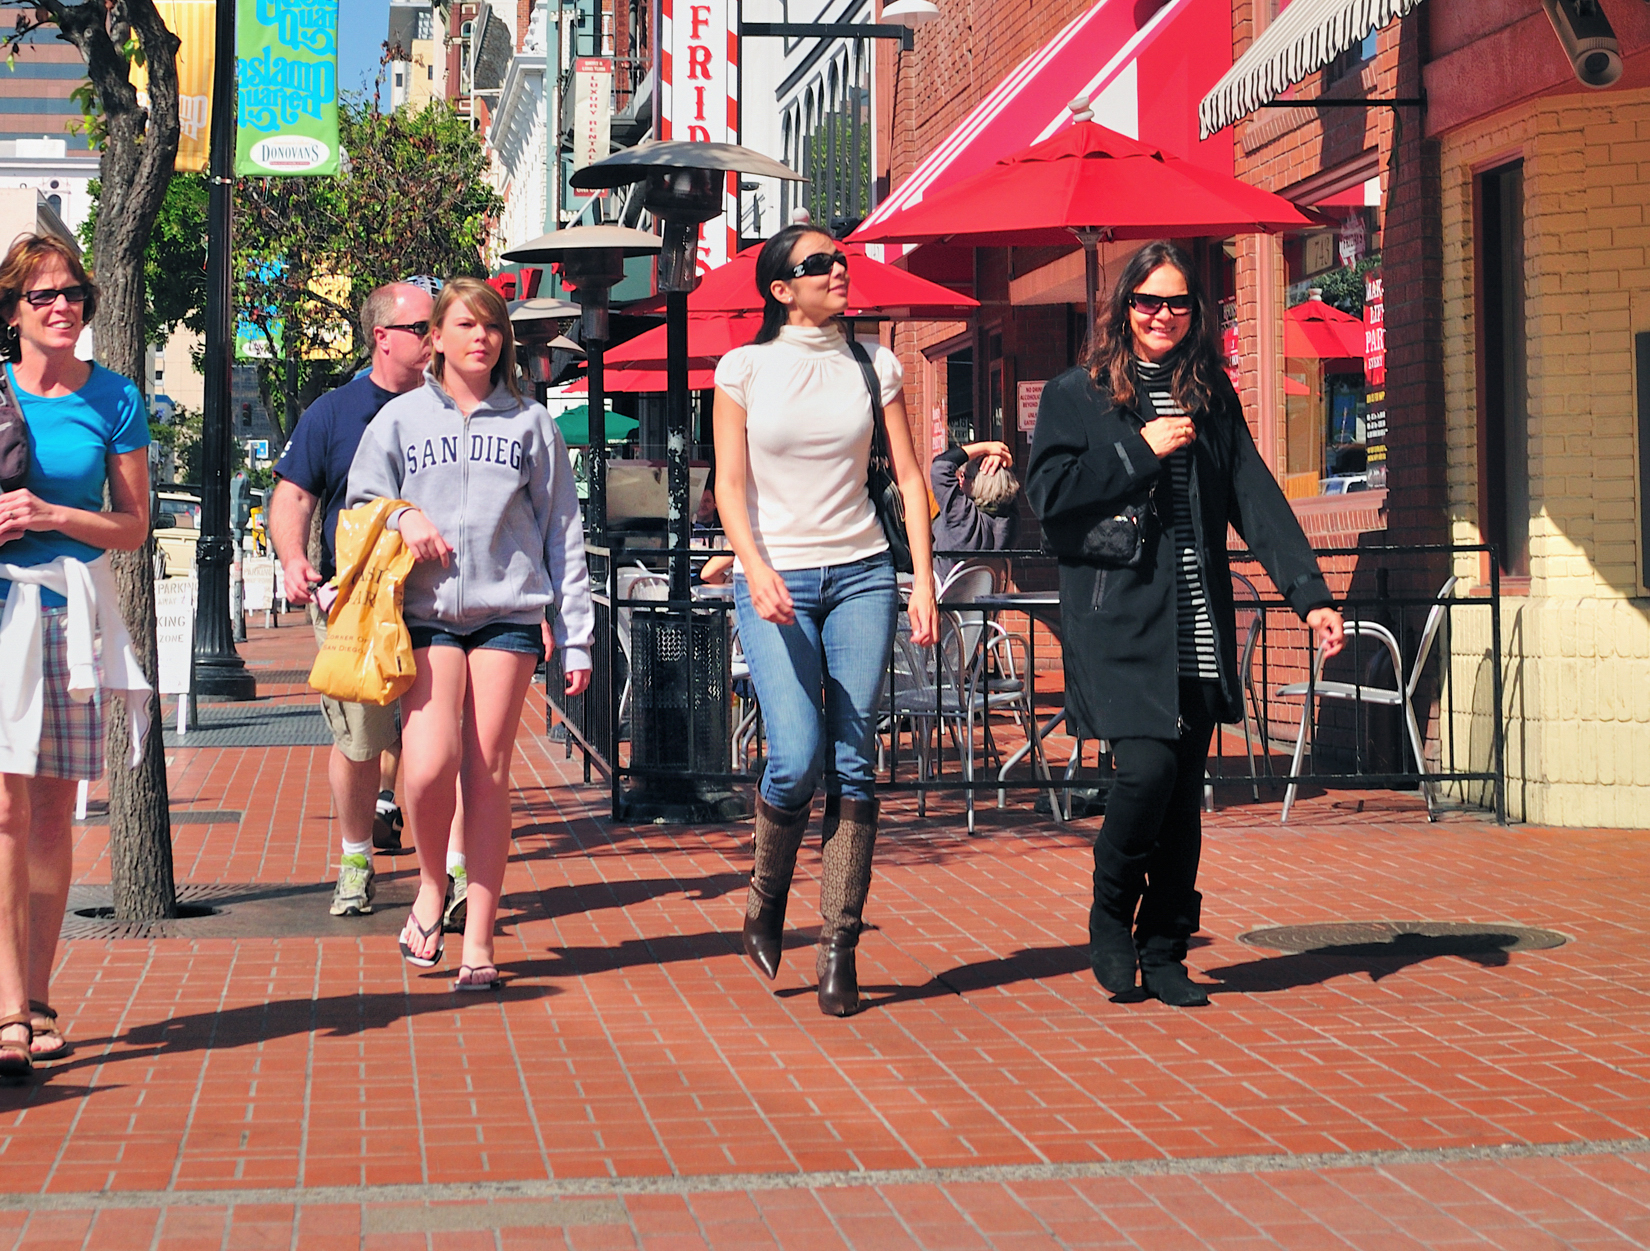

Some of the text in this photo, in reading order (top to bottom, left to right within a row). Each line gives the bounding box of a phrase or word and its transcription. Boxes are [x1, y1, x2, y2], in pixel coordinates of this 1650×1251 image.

[590, 76, 598, 115] LUXURY
[1365, 278, 1384, 302] MAK
[1365, 327, 1386, 354] PAR
[407, 434, 523, 474] SAN DIEG
[159, 634, 184, 643] ZONE
